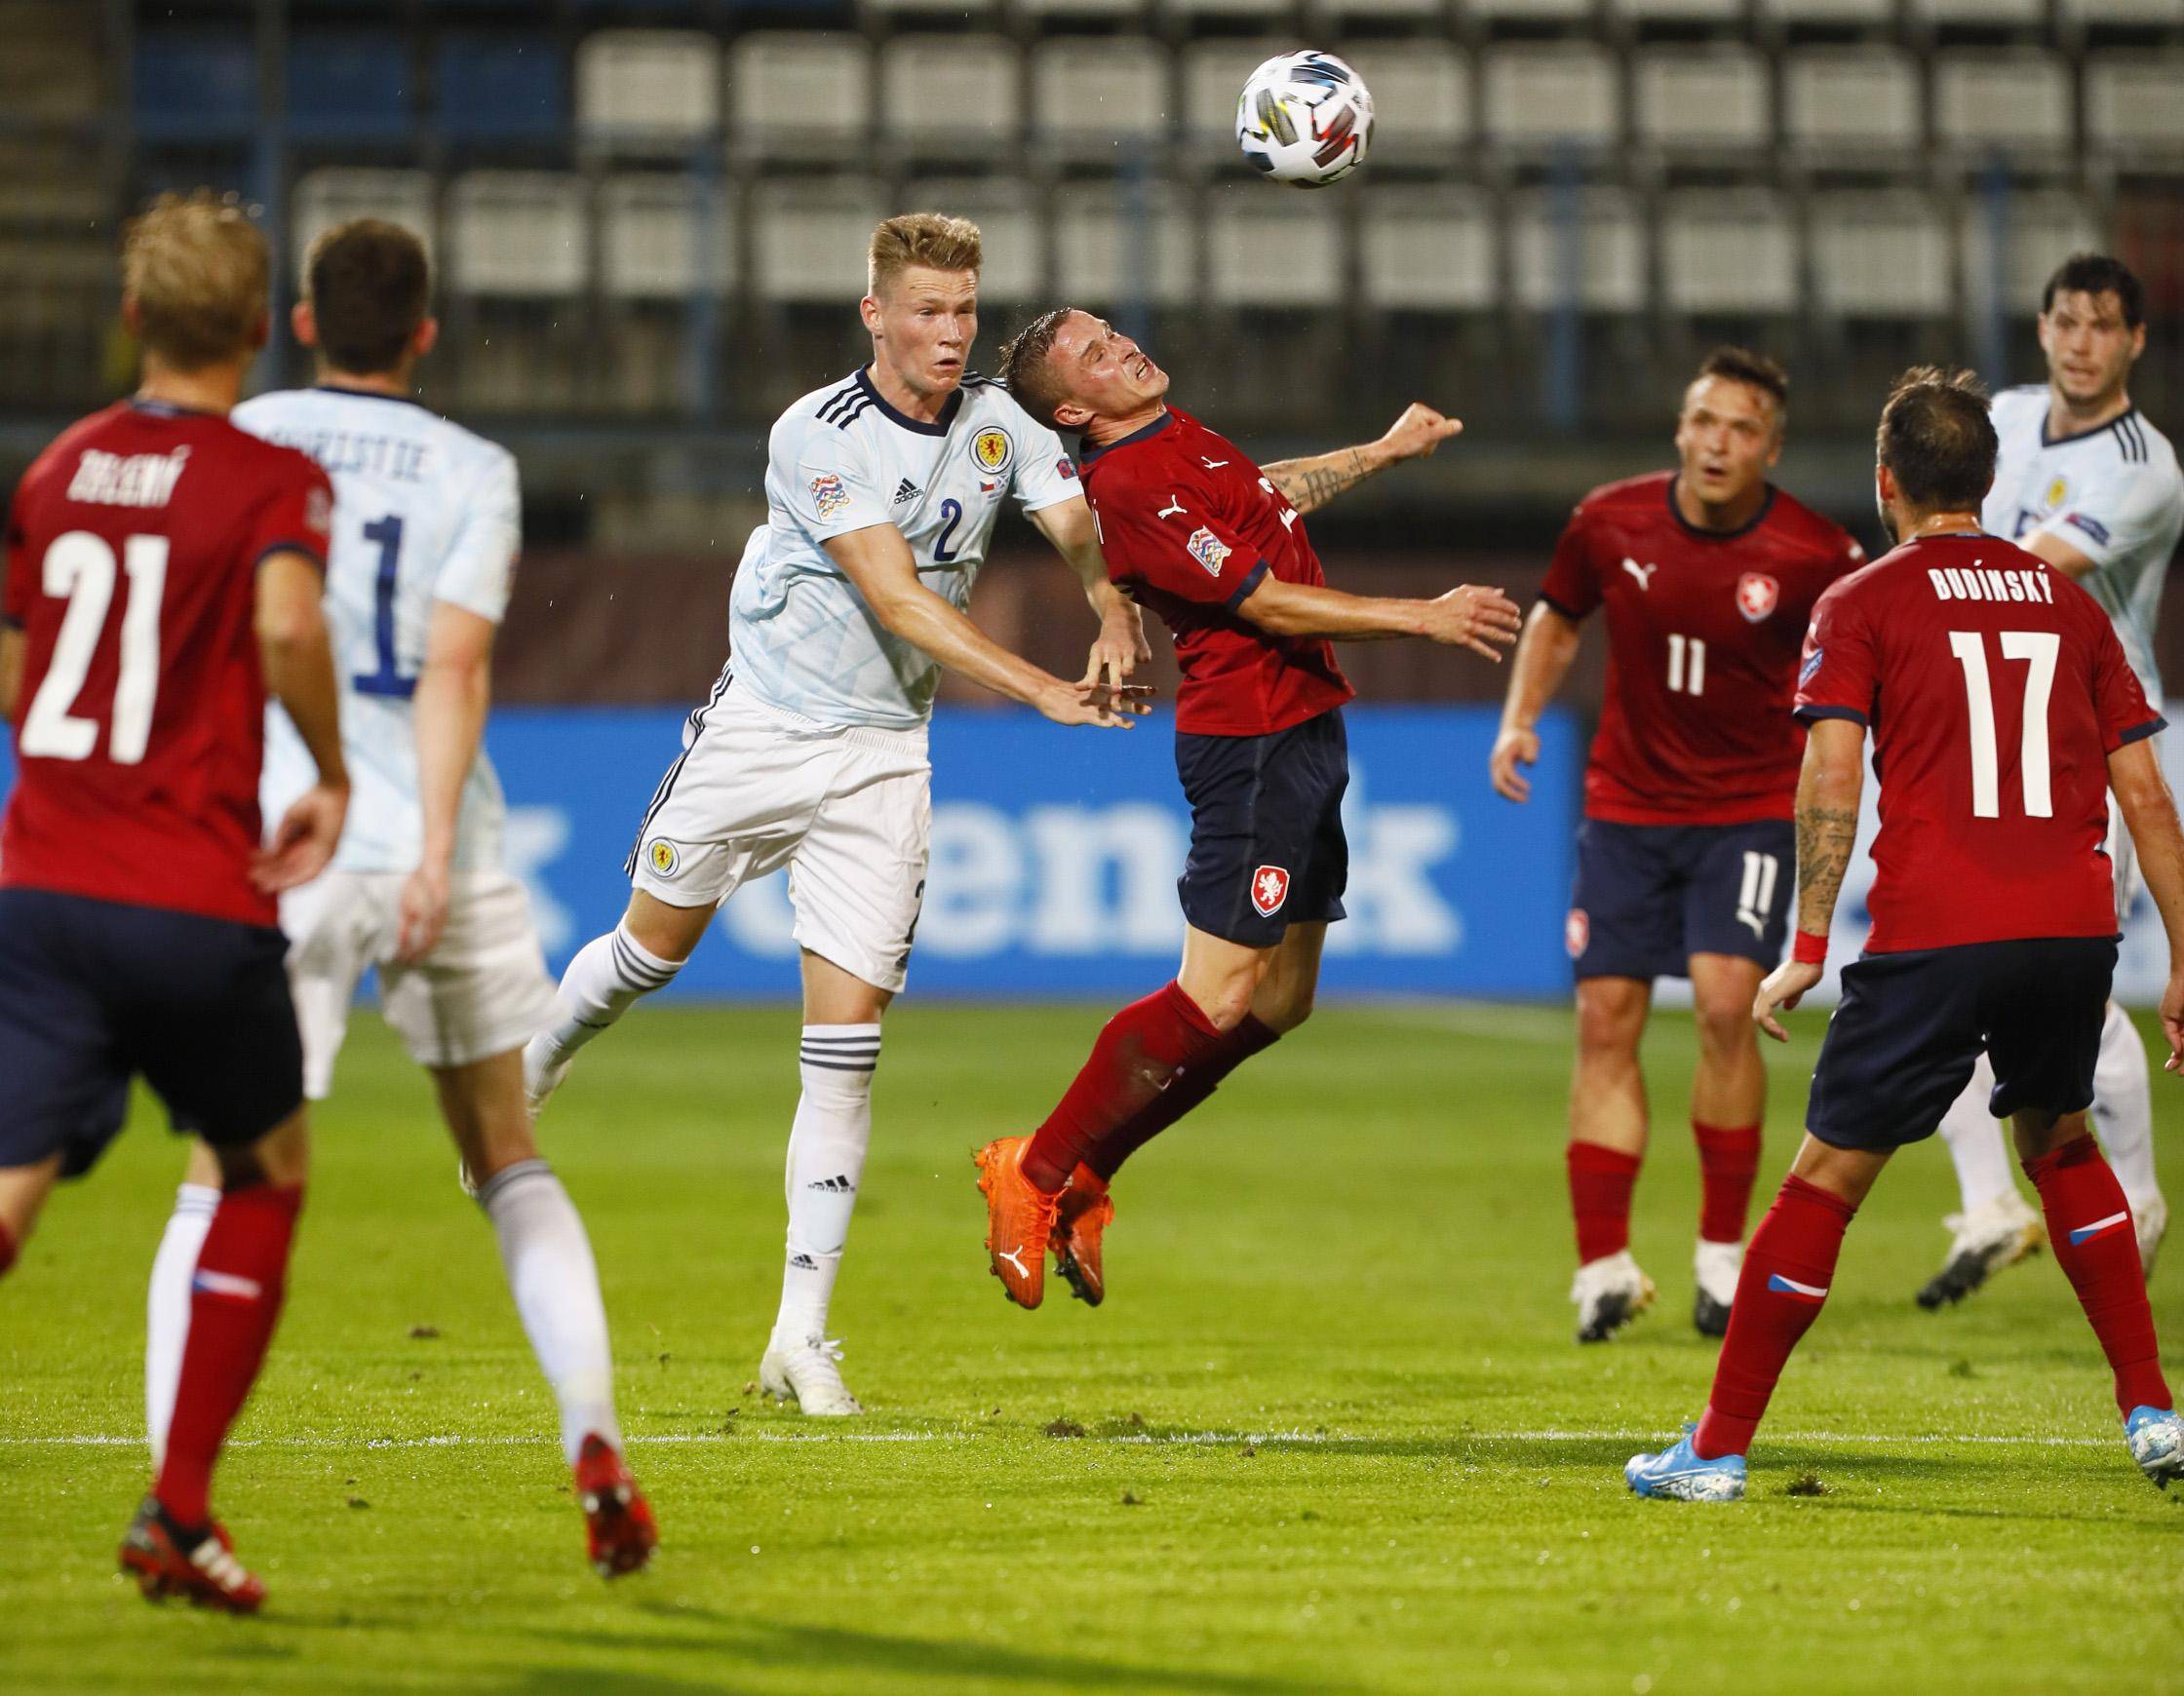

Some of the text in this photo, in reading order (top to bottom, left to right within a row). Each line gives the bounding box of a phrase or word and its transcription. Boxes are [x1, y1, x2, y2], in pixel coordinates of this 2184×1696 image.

[894, 488, 924, 505] adidas
[934, 498, 962, 561] 2
[1928, 559, 2053, 604] BUDÍNSKÝ
[21, 531, 170, 763] 21
[1667, 634, 1705, 696] 11
[1948, 631, 2061, 818] 17
[1738, 851, 1778, 914] 11
